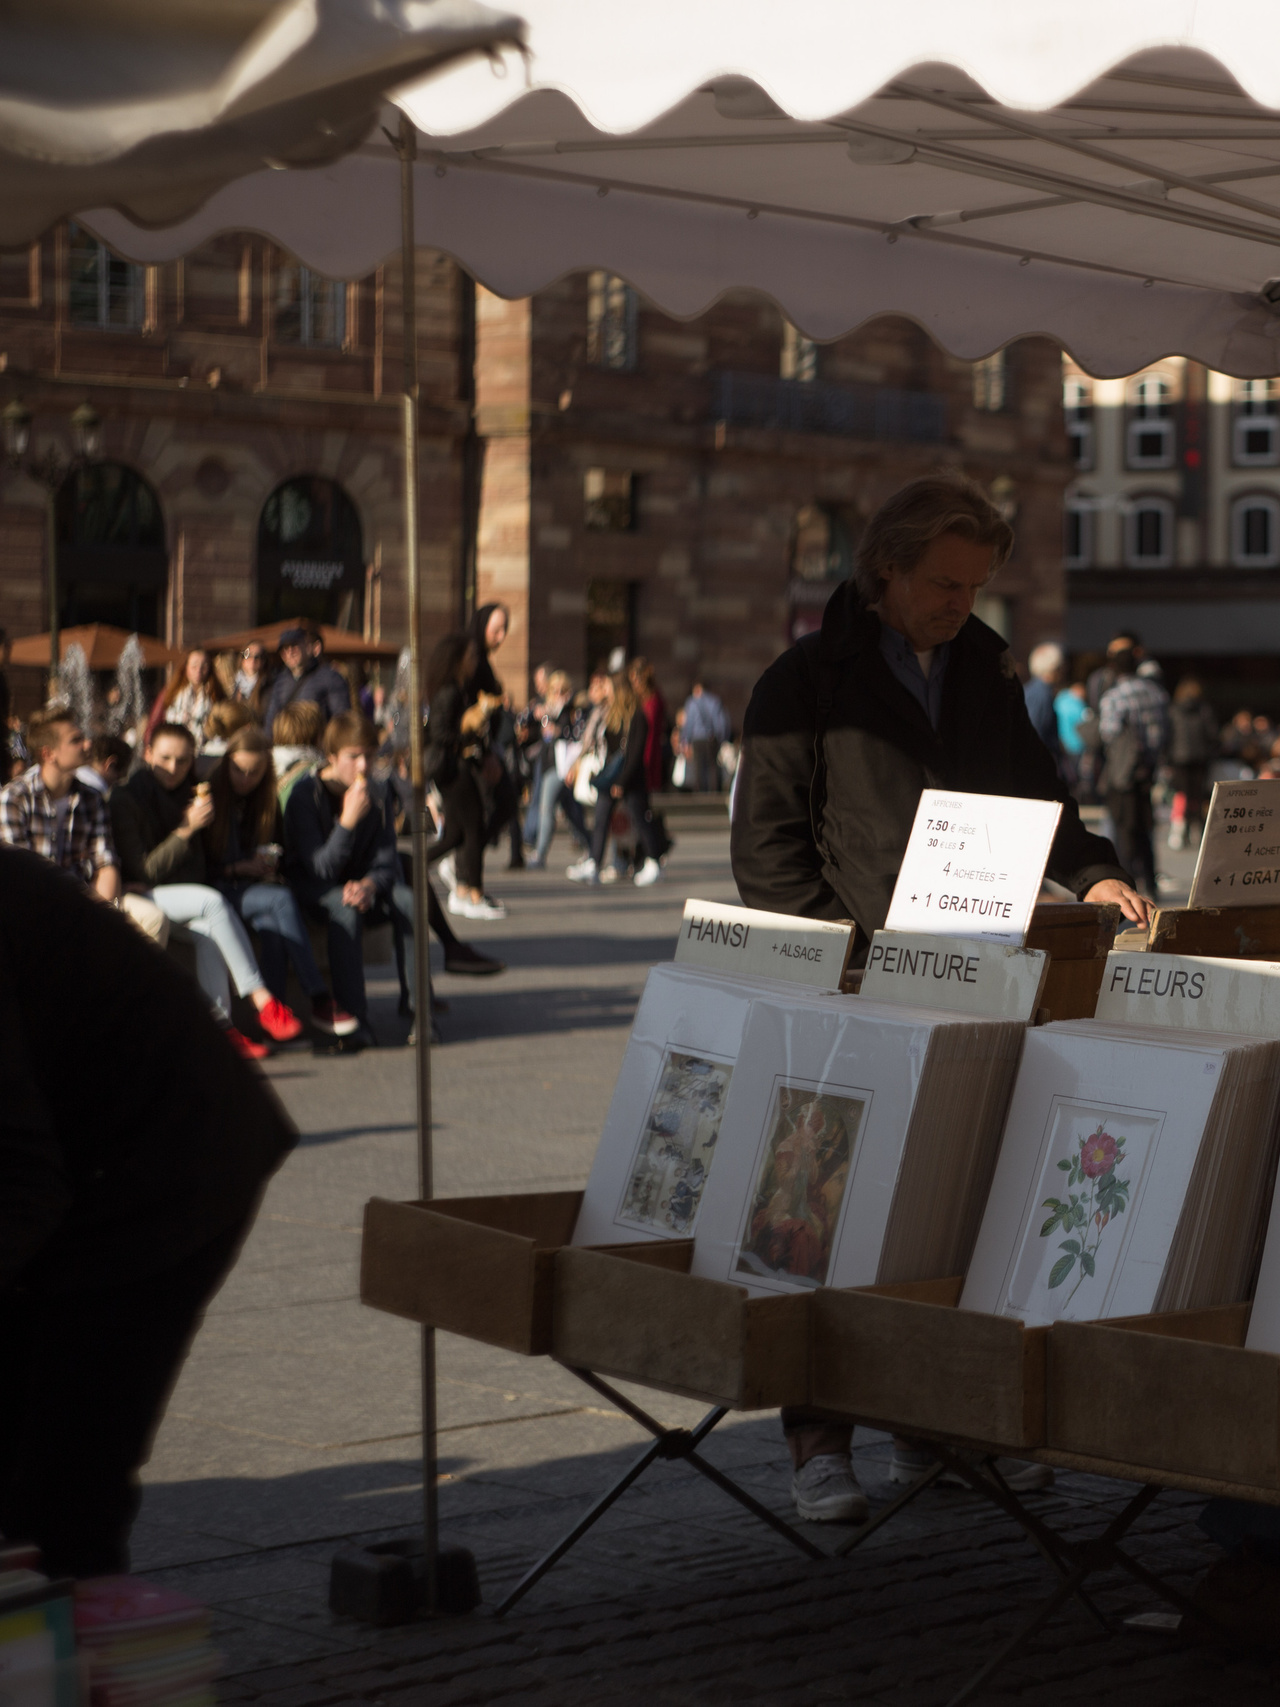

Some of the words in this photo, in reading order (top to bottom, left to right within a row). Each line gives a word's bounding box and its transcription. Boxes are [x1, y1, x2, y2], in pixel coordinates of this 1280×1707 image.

[1227, 789, 1258, 797] AFFICHES
[932, 799, 963, 810] AFFICHES
[1224, 807, 1246, 819] 7.50
[926, 819, 949, 832] 7.50
[950, 823, 957, 833] €
[1226, 825, 1238, 834] 30
[1258, 823, 1265, 832] 5
[927, 838, 939, 848] 30
[945, 841, 957, 850] LES
[958, 841, 965, 851] 5
[1244, 842, 1252, 857] 4
[943, 861, 952, 876] 4
[953, 867, 996, 883] ACHETÉES
[1229, 872, 1236, 887] 1
[910, 893, 918, 903] +
[925, 893, 933, 908] 1
[938, 895, 1013, 919] GRATUITE
[687, 915, 751, 949] HANSI
[779, 942, 823, 963] ALSACE
[868, 945, 980, 984] PEINTURE
[1109, 966, 1205, 1000] FLEURS
